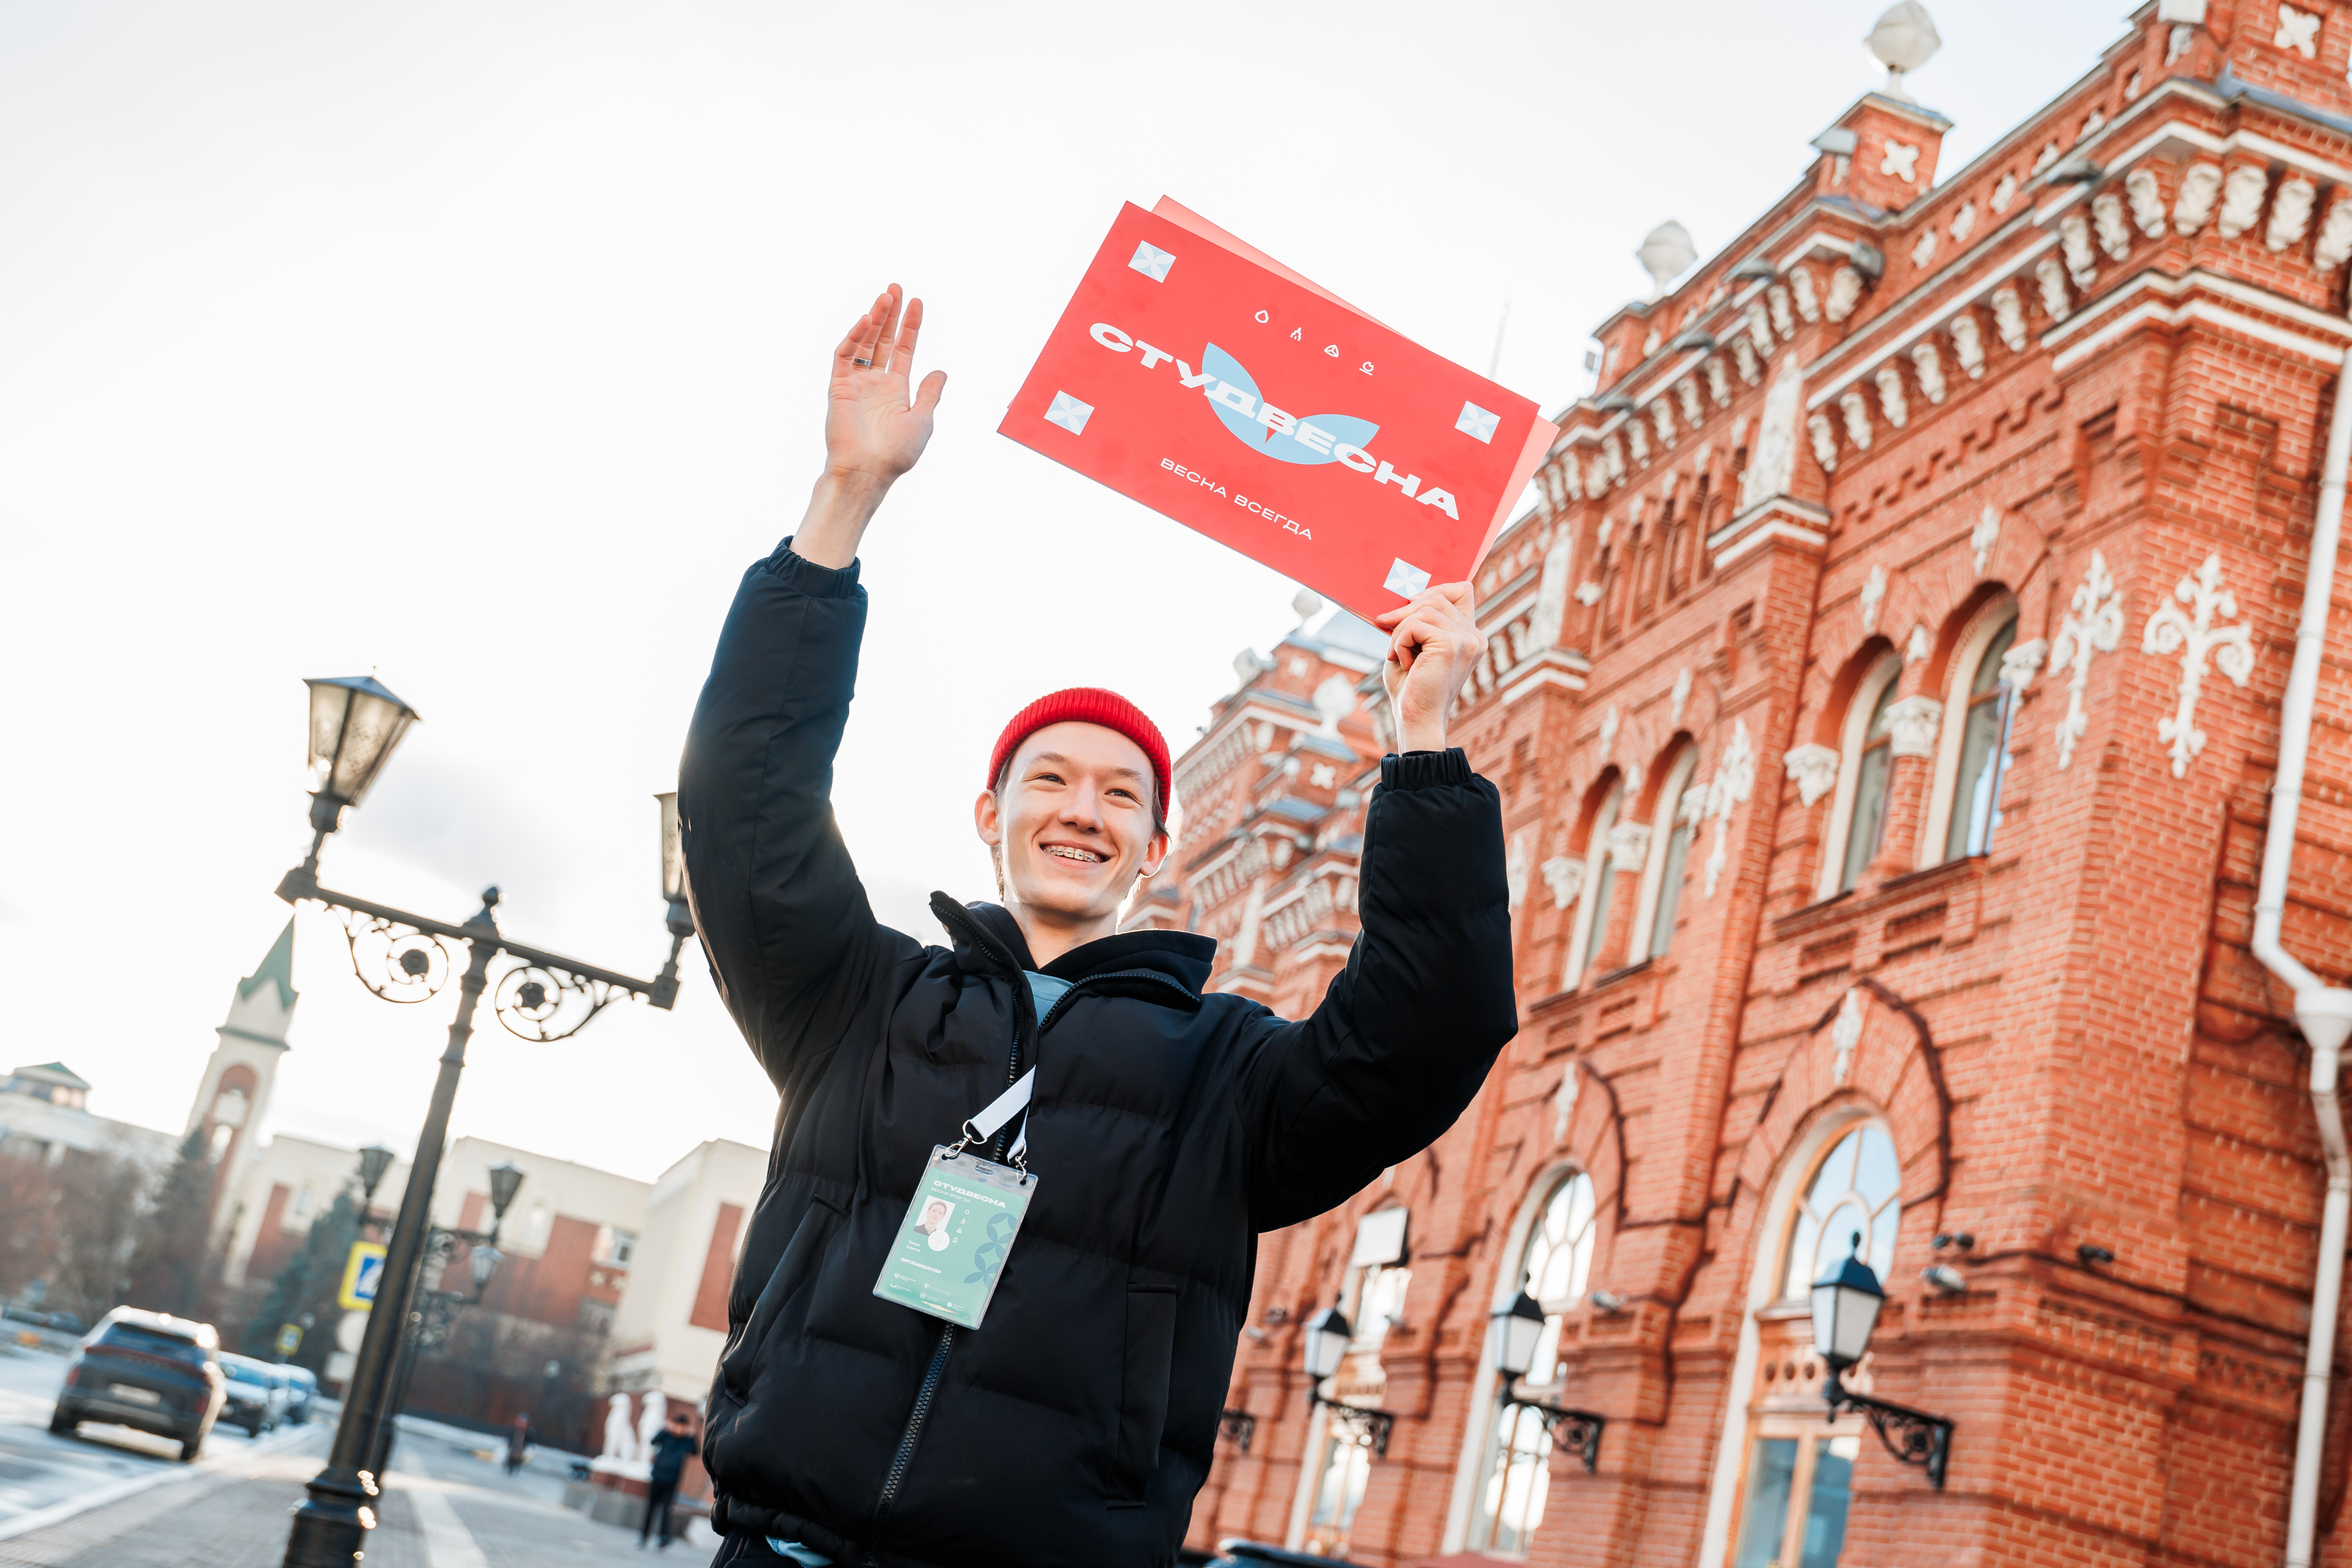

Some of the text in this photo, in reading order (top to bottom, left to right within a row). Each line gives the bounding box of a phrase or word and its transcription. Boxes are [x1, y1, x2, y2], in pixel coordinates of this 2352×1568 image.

[1090, 323, 1459, 520] СТУДВЕСНА
[1160, 458, 1312, 540] ВЕСНА ВСЕГДА
[931, 1187, 971, 1203] ВЕСНА ВСЕГДА
[933, 1180, 1005, 1208] СТУДВЕСНА
[900, 1258, 942, 1274] ОРГАНИЗАТОР
